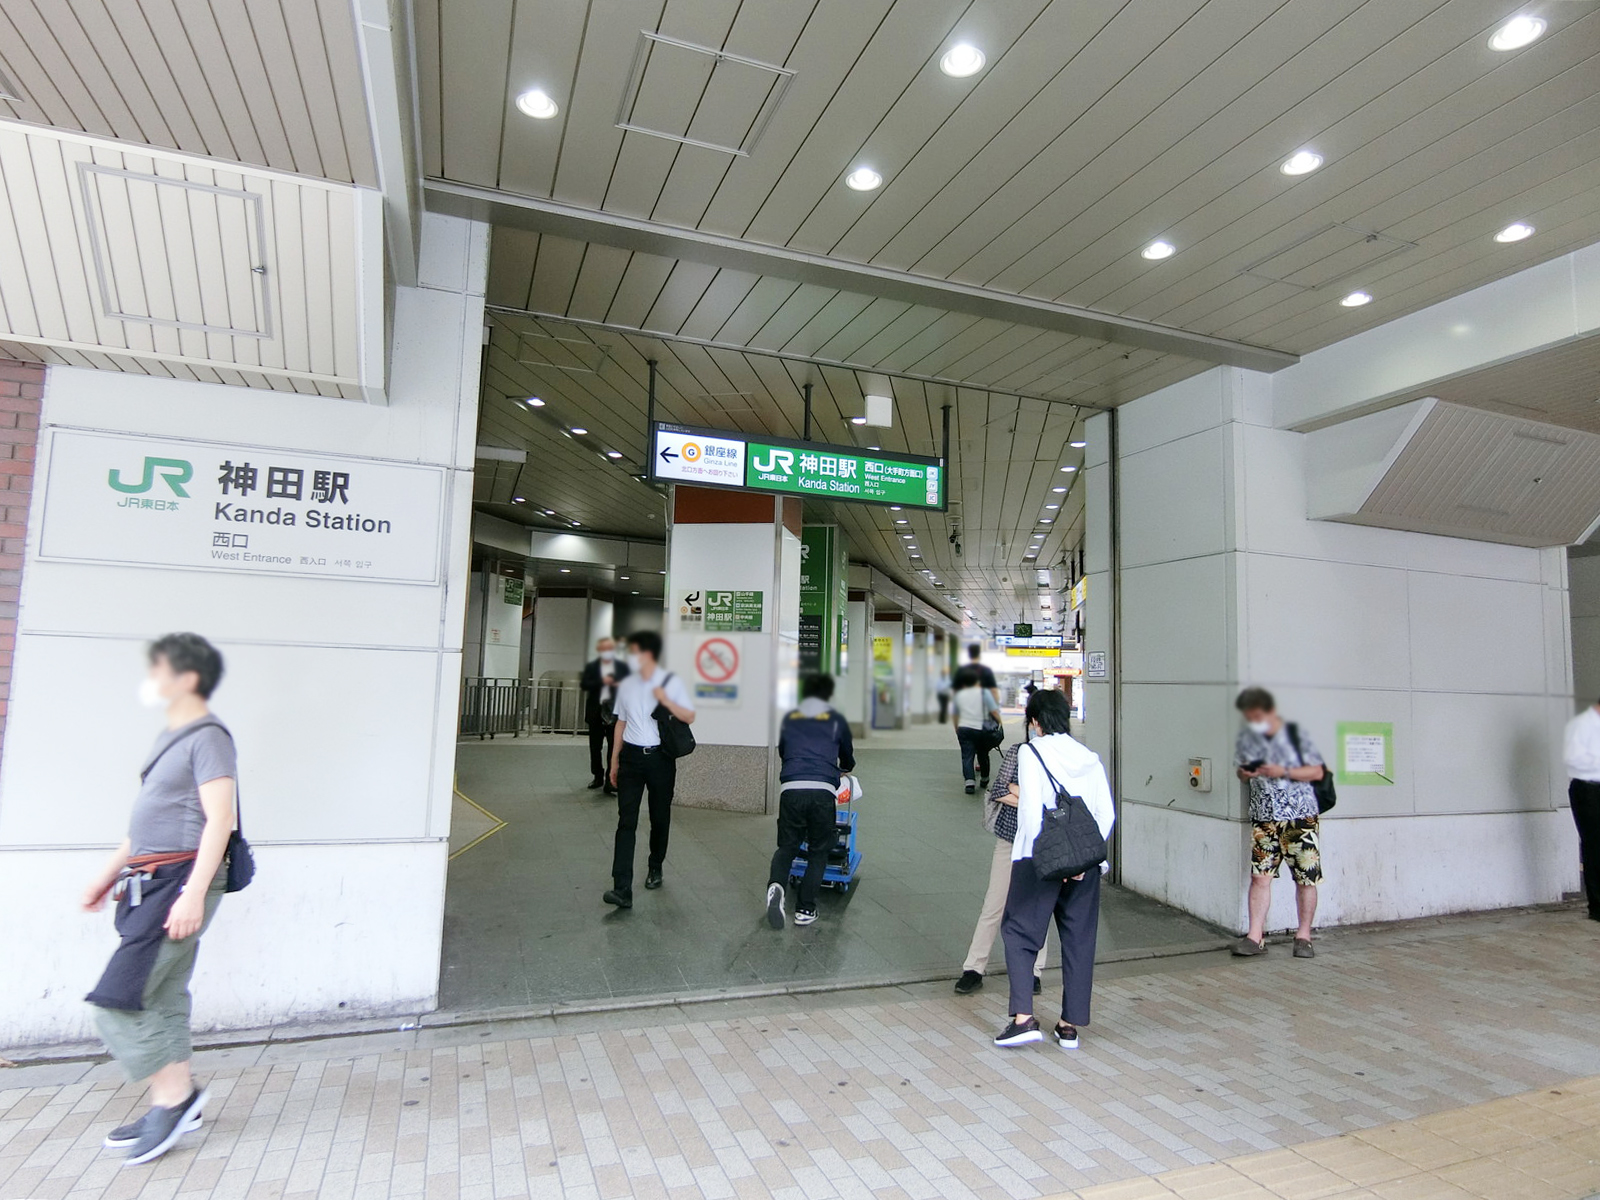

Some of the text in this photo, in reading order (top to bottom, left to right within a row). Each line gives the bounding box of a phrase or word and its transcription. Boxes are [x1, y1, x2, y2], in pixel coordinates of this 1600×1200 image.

[704, 444, 738, 459] 銀座線
[703, 457, 723, 467] Ginza
[753, 448, 794, 475] JR
[799, 453, 857, 479] 神田駅
[107, 455, 194, 499] JR
[217, 460, 351, 505] 神田駅
[758, 473, 789, 483] JR東日本
[798, 476, 860, 494] Kanda Station
[864, 473, 906, 484] West Entrance
[116, 495, 180, 512] JR東日本
[214, 501, 393, 534] Kanda Station
[212, 531, 249, 549] 西口
[211, 549, 240, 561] West
[243, 552, 292, 565] Entrance
[299, 556, 327, 566] 西入口
[707, 592, 732, 606] JR
[707, 612, 733, 622] 神田駅
